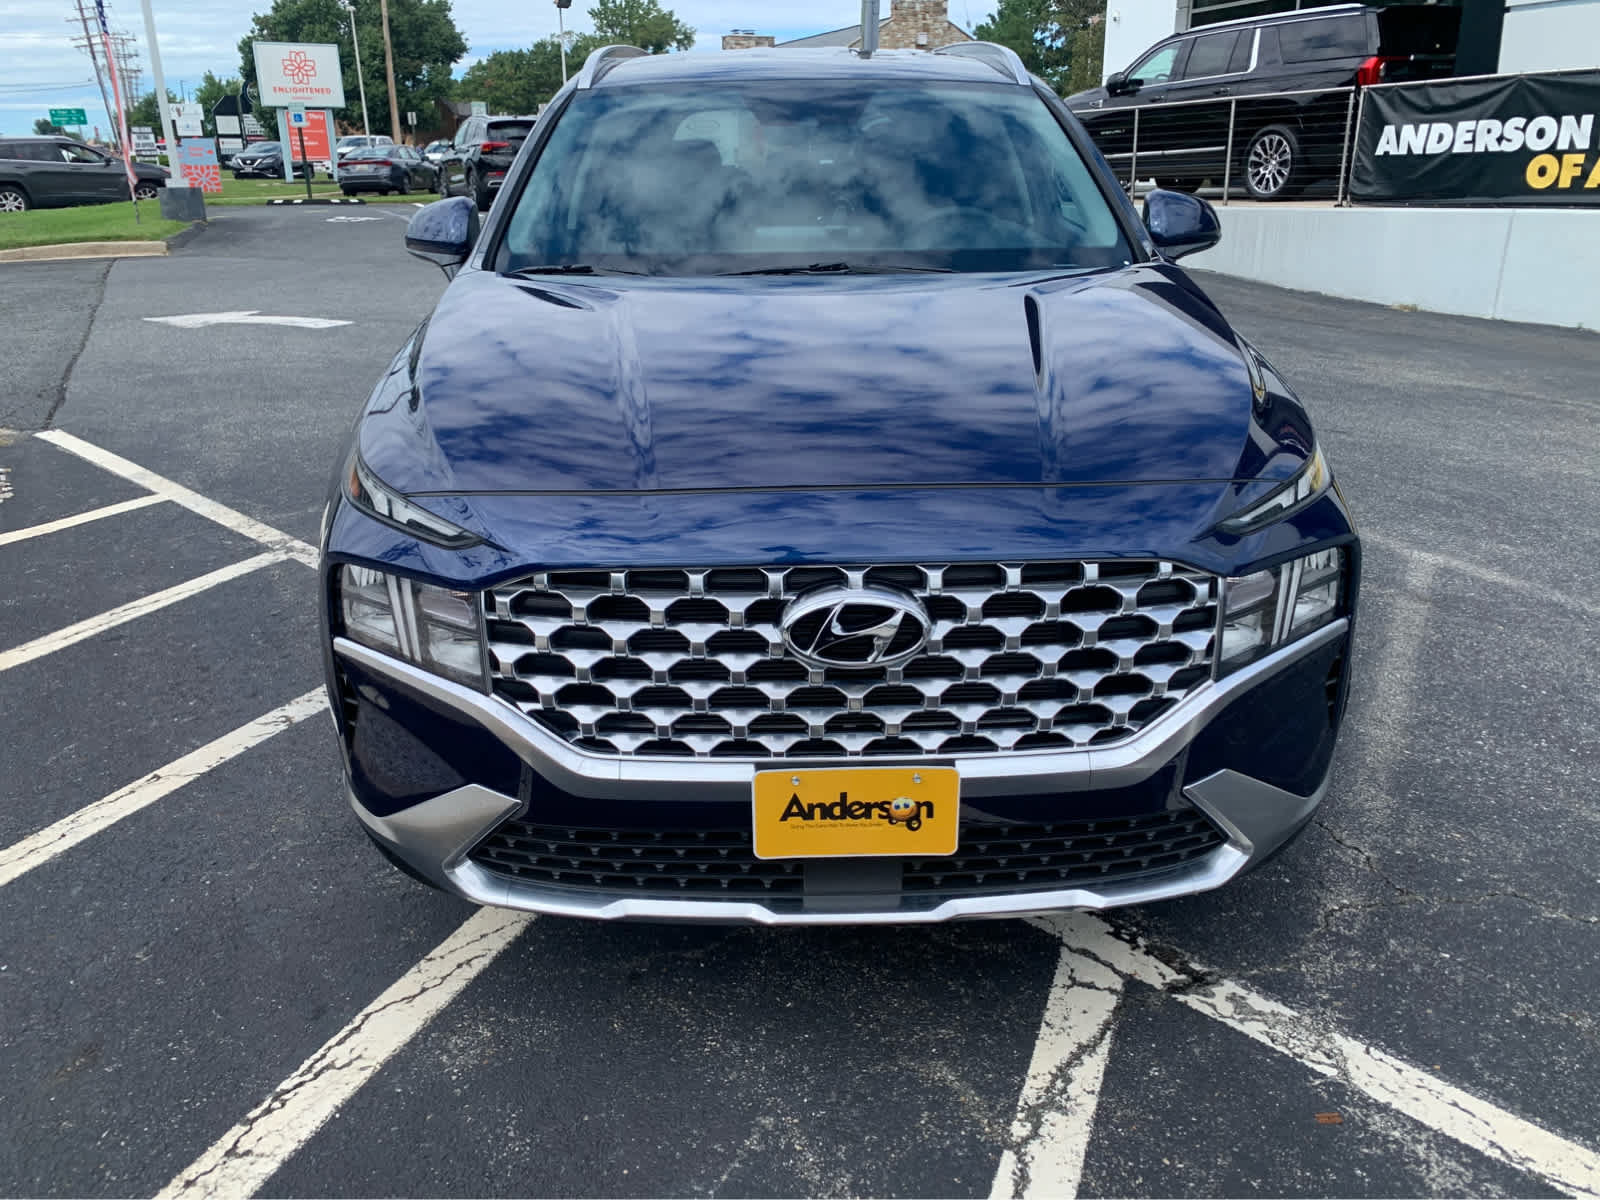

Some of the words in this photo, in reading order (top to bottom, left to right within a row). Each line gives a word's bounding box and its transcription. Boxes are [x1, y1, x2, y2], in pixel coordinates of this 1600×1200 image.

[272, 86, 332, 95] ENLIGHTENED
[1375, 114, 1594, 155] ANDERSON
[1525, 153, 1586, 189] OF
[779, 791, 934, 823] Anderson
